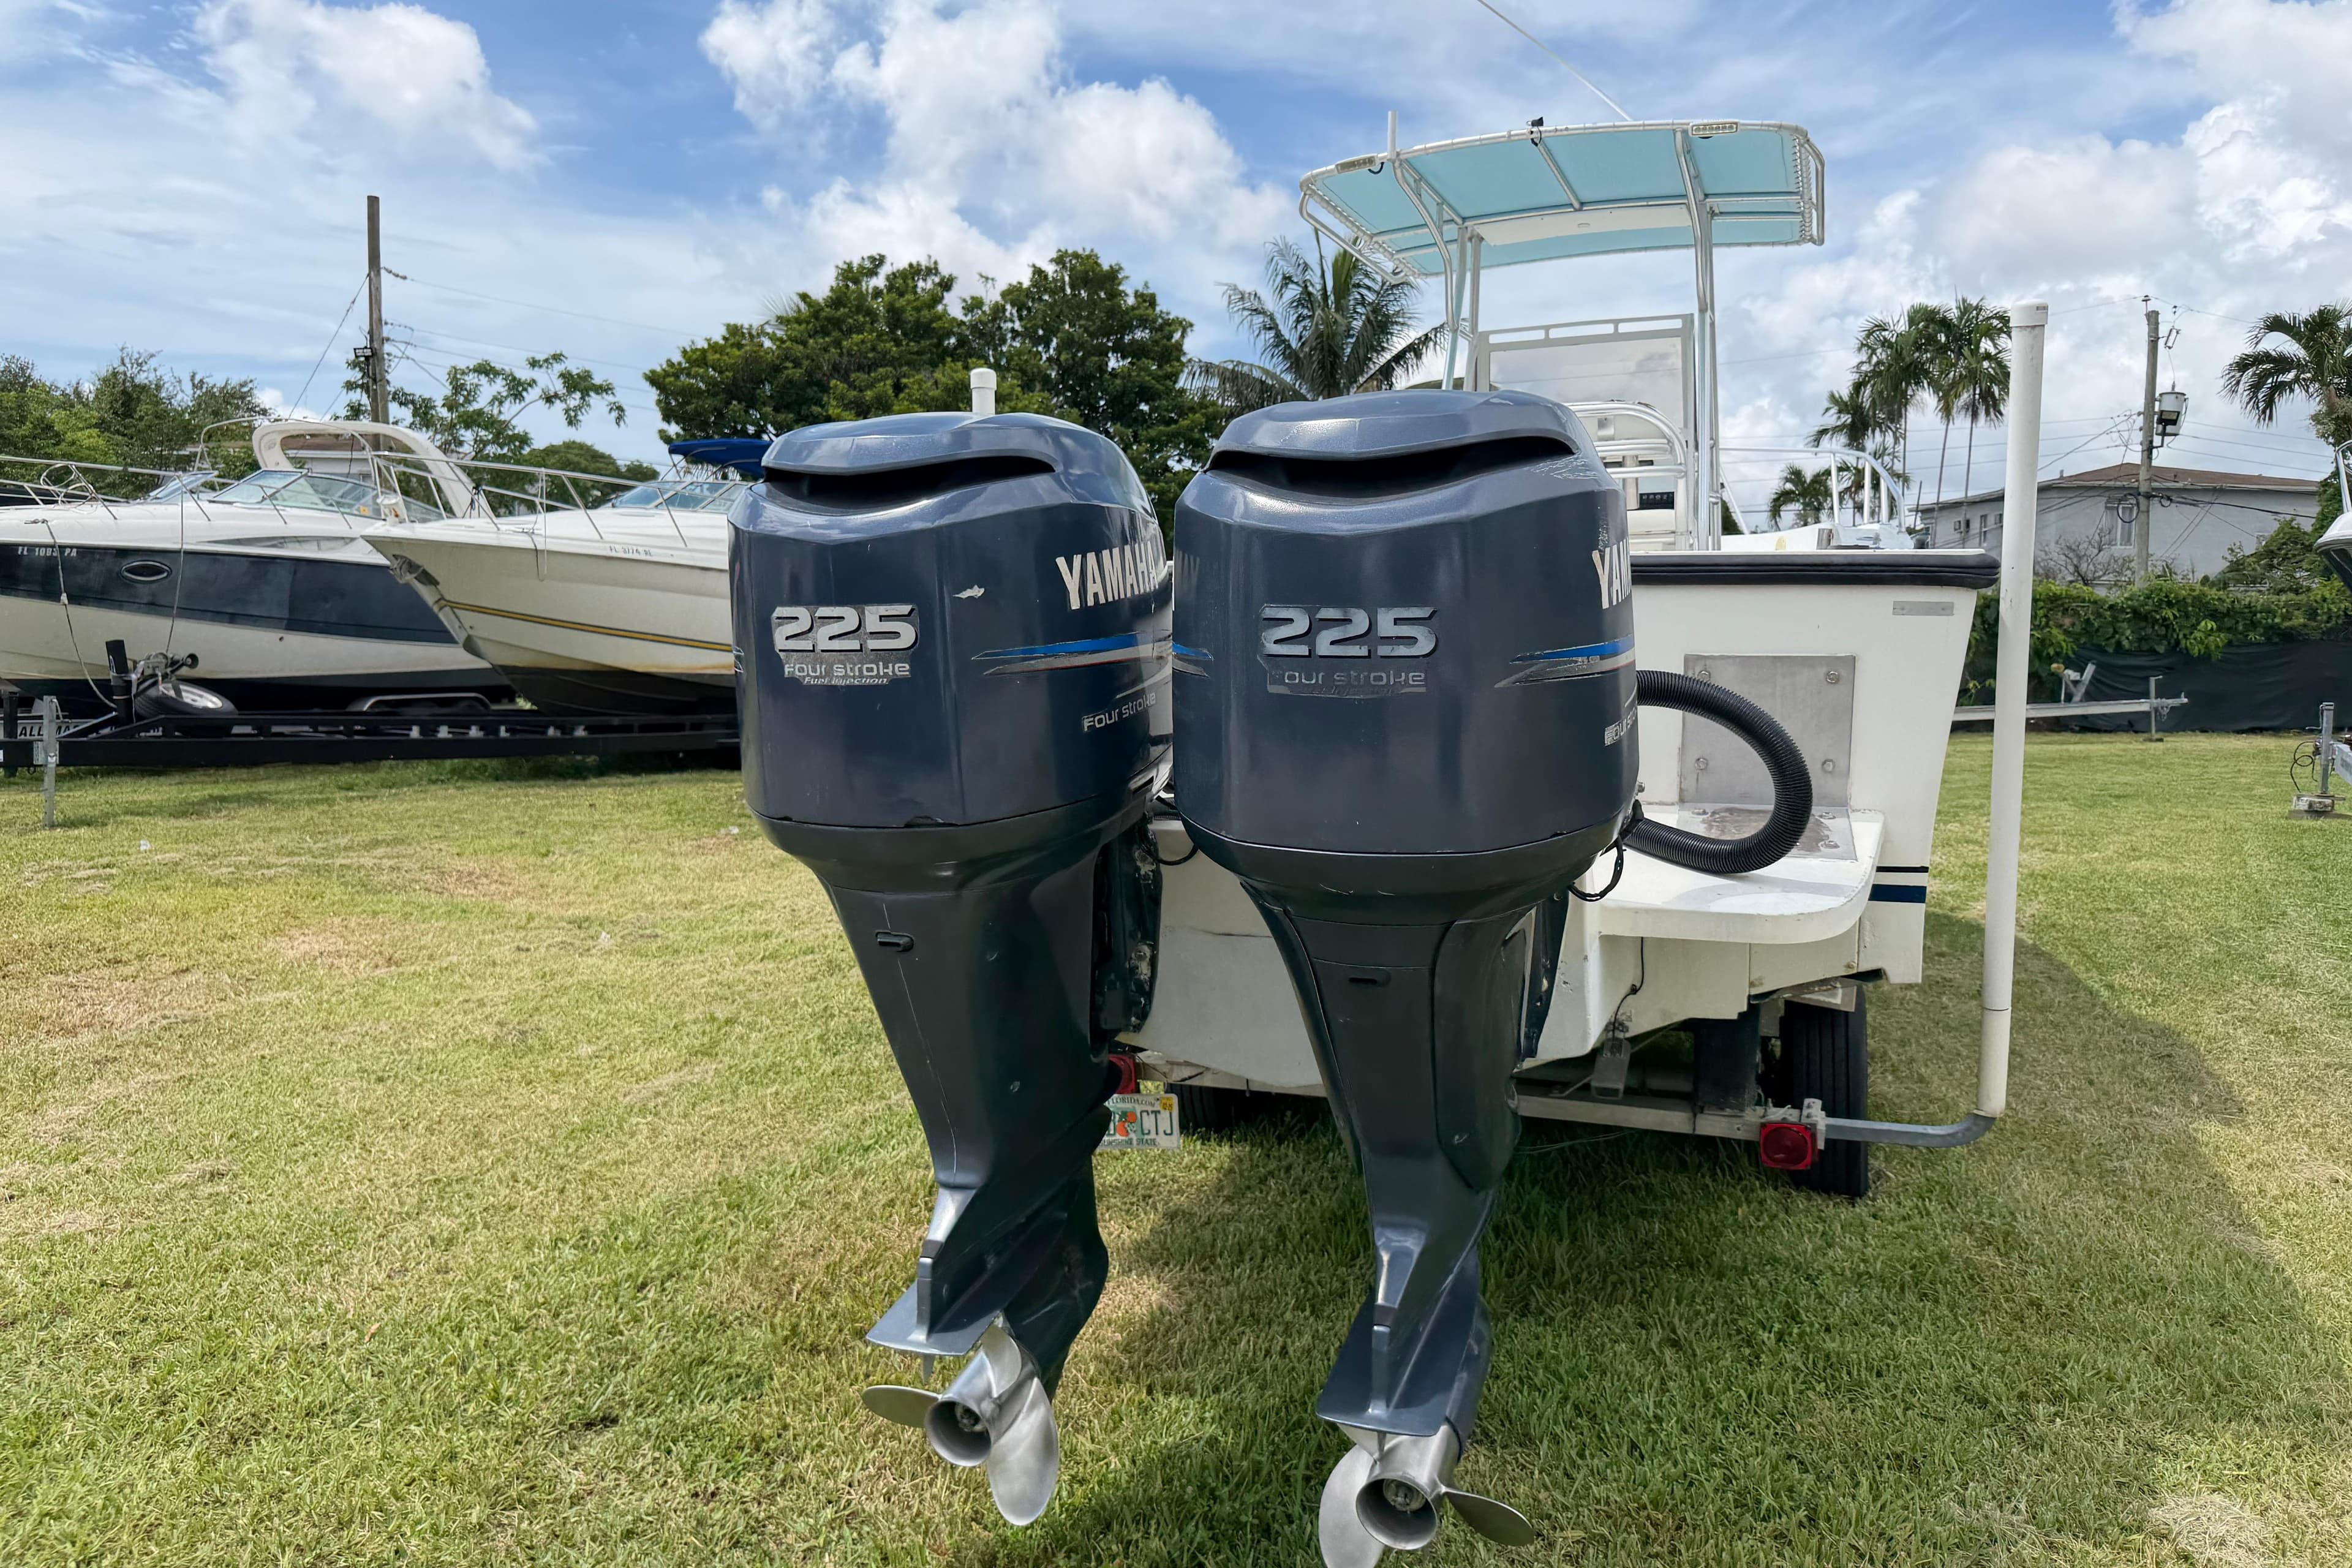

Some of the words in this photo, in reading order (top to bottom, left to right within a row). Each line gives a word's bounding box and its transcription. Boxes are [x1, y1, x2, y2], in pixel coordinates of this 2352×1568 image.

[18, 546, 28, 555] FL
[1055, 541, 1158, 610] YAMAHA
[771, 605, 916, 653] 225
[1261, 607, 1438, 658] 225
[1272, 671, 1324, 685] our
[1333, 670, 1426, 685] stroke
[1083, 708, 1119, 732] Four
[1121, 692, 1156, 718] stroke
[1140, 1109, 1174, 1136] CTJ
